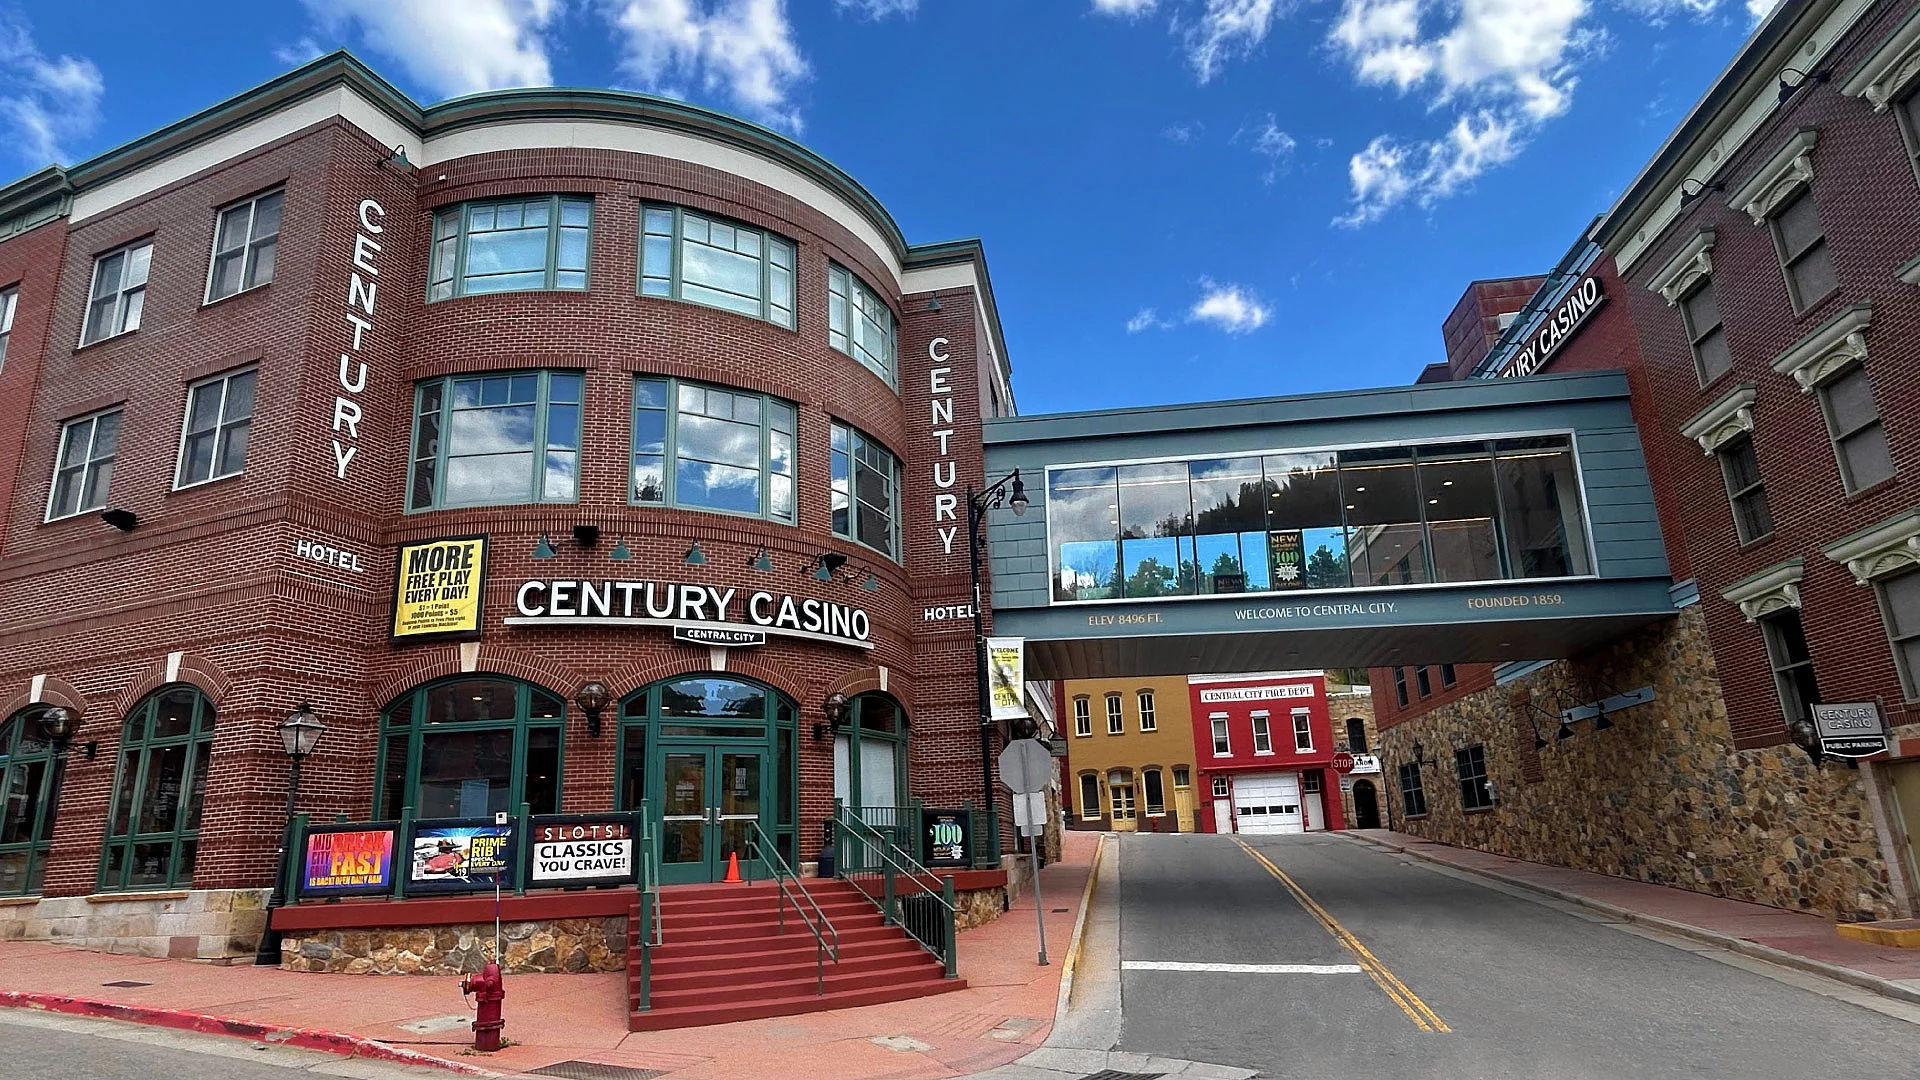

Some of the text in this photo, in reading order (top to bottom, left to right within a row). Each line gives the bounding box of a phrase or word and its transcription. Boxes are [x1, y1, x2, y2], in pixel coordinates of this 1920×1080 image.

[1540, 277, 1597, 354] CASINO
[331, 199, 386, 480] CENTURY
[929, 337, 958, 555] CENTURY
[1271, 534, 1298, 543] NEW
[296, 539, 364, 573] HOTEL
[408, 544, 474, 574] MORE
[407, 570, 471, 590] FREE PLAY
[405, 586, 469, 604] EVERY DAY!
[1467, 594, 1565, 609] FOUNDED 1859.
[411, 611, 425, 619] 1000
[425, 610, 444, 618] Points
[516, 580, 871, 641] CENTURY CASINO
[924, 604, 975, 621] HOTEL
[1234, 602, 1398, 620] WELCOME TO CENTRAL CITY.
[1088, 613, 1163, 626] ELEV 8496 FT.
[687, 629, 755, 641] CENTRAL CITY
[1204, 690, 1244, 701] CENTRAL
[1244, 689, 1263, 699] CITY
[1265, 688, 1286, 698] FIRE
[1820, 708, 1874, 720] CENTURY
[1828, 719, 1872, 729] CASINO
[1333, 759, 1353, 768] STOP
[544, 824, 624, 841] SLOTS!
[929, 823, 963, 845] $100
[313, 834, 332, 851] MID
[333, 831, 386, 852] BREAK
[472, 837, 507, 848] PRIME
[312, 851, 330, 865] CITY
[471, 846, 494, 858] RIB
[540, 842, 624, 859] CLASSICS
[330, 850, 385, 876] FAST
[540, 857, 626, 873] YOU CRAVE!
[309, 877, 316, 886] IS
[335, 876, 351, 885] OPEN
